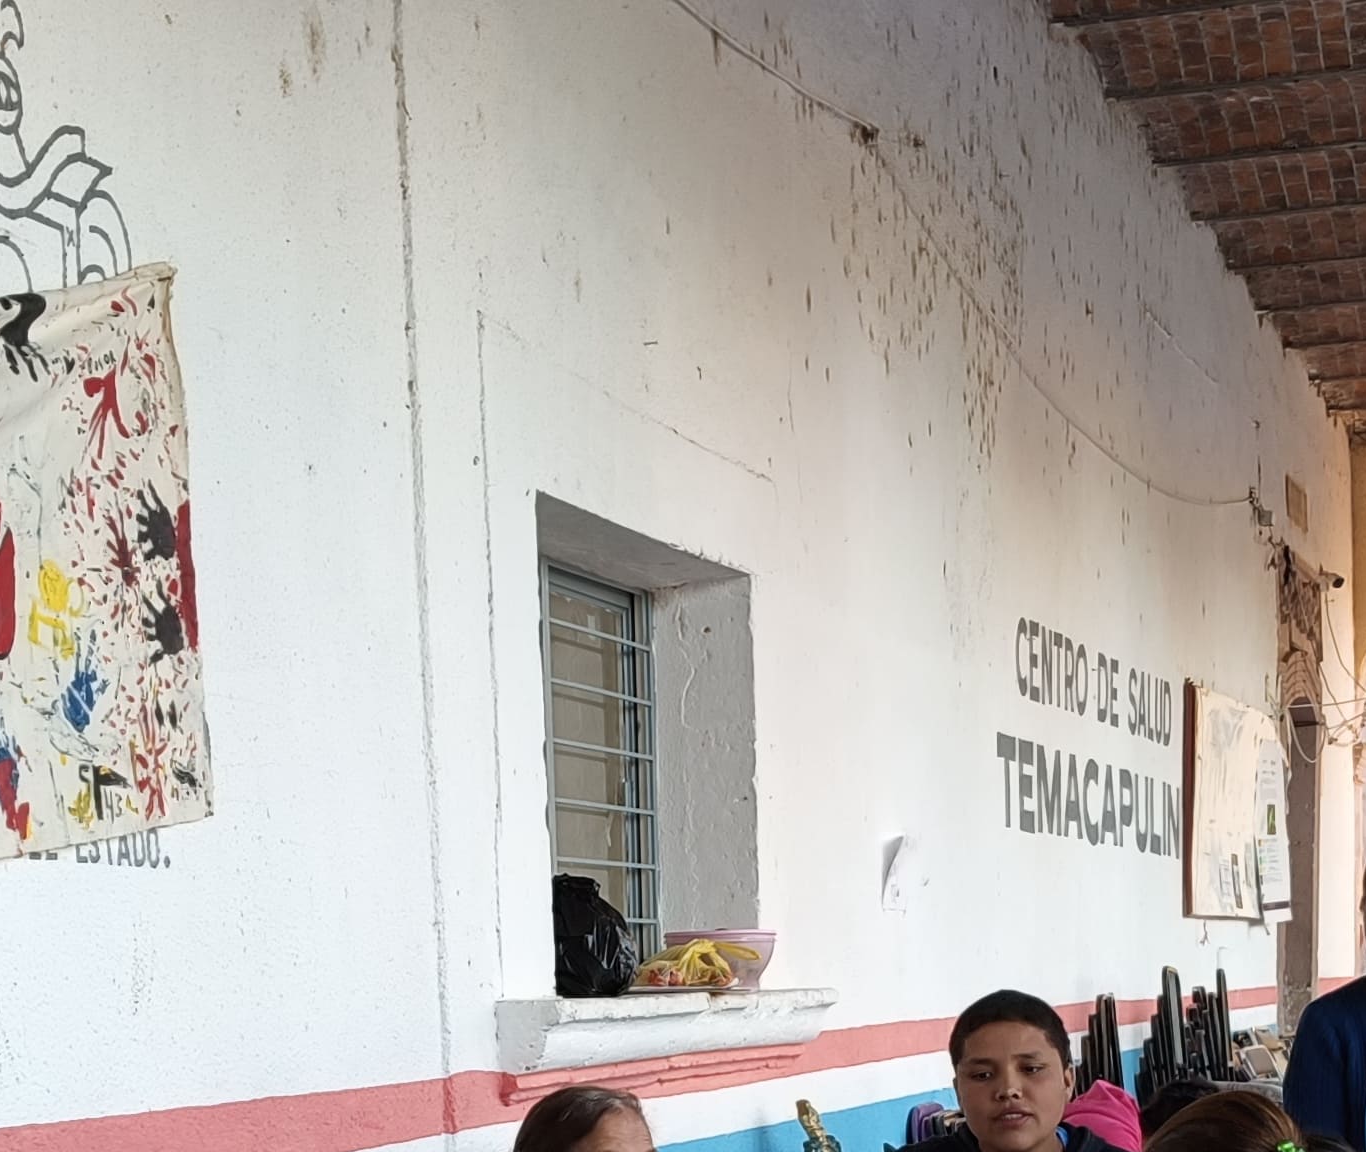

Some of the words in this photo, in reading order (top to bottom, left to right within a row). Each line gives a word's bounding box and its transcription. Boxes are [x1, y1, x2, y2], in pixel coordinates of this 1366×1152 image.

[1015, 616, 1089, 717] CENTRO
[1096, 651, 1119, 728] DE
[1127, 667, 1172, 747] SALUD
